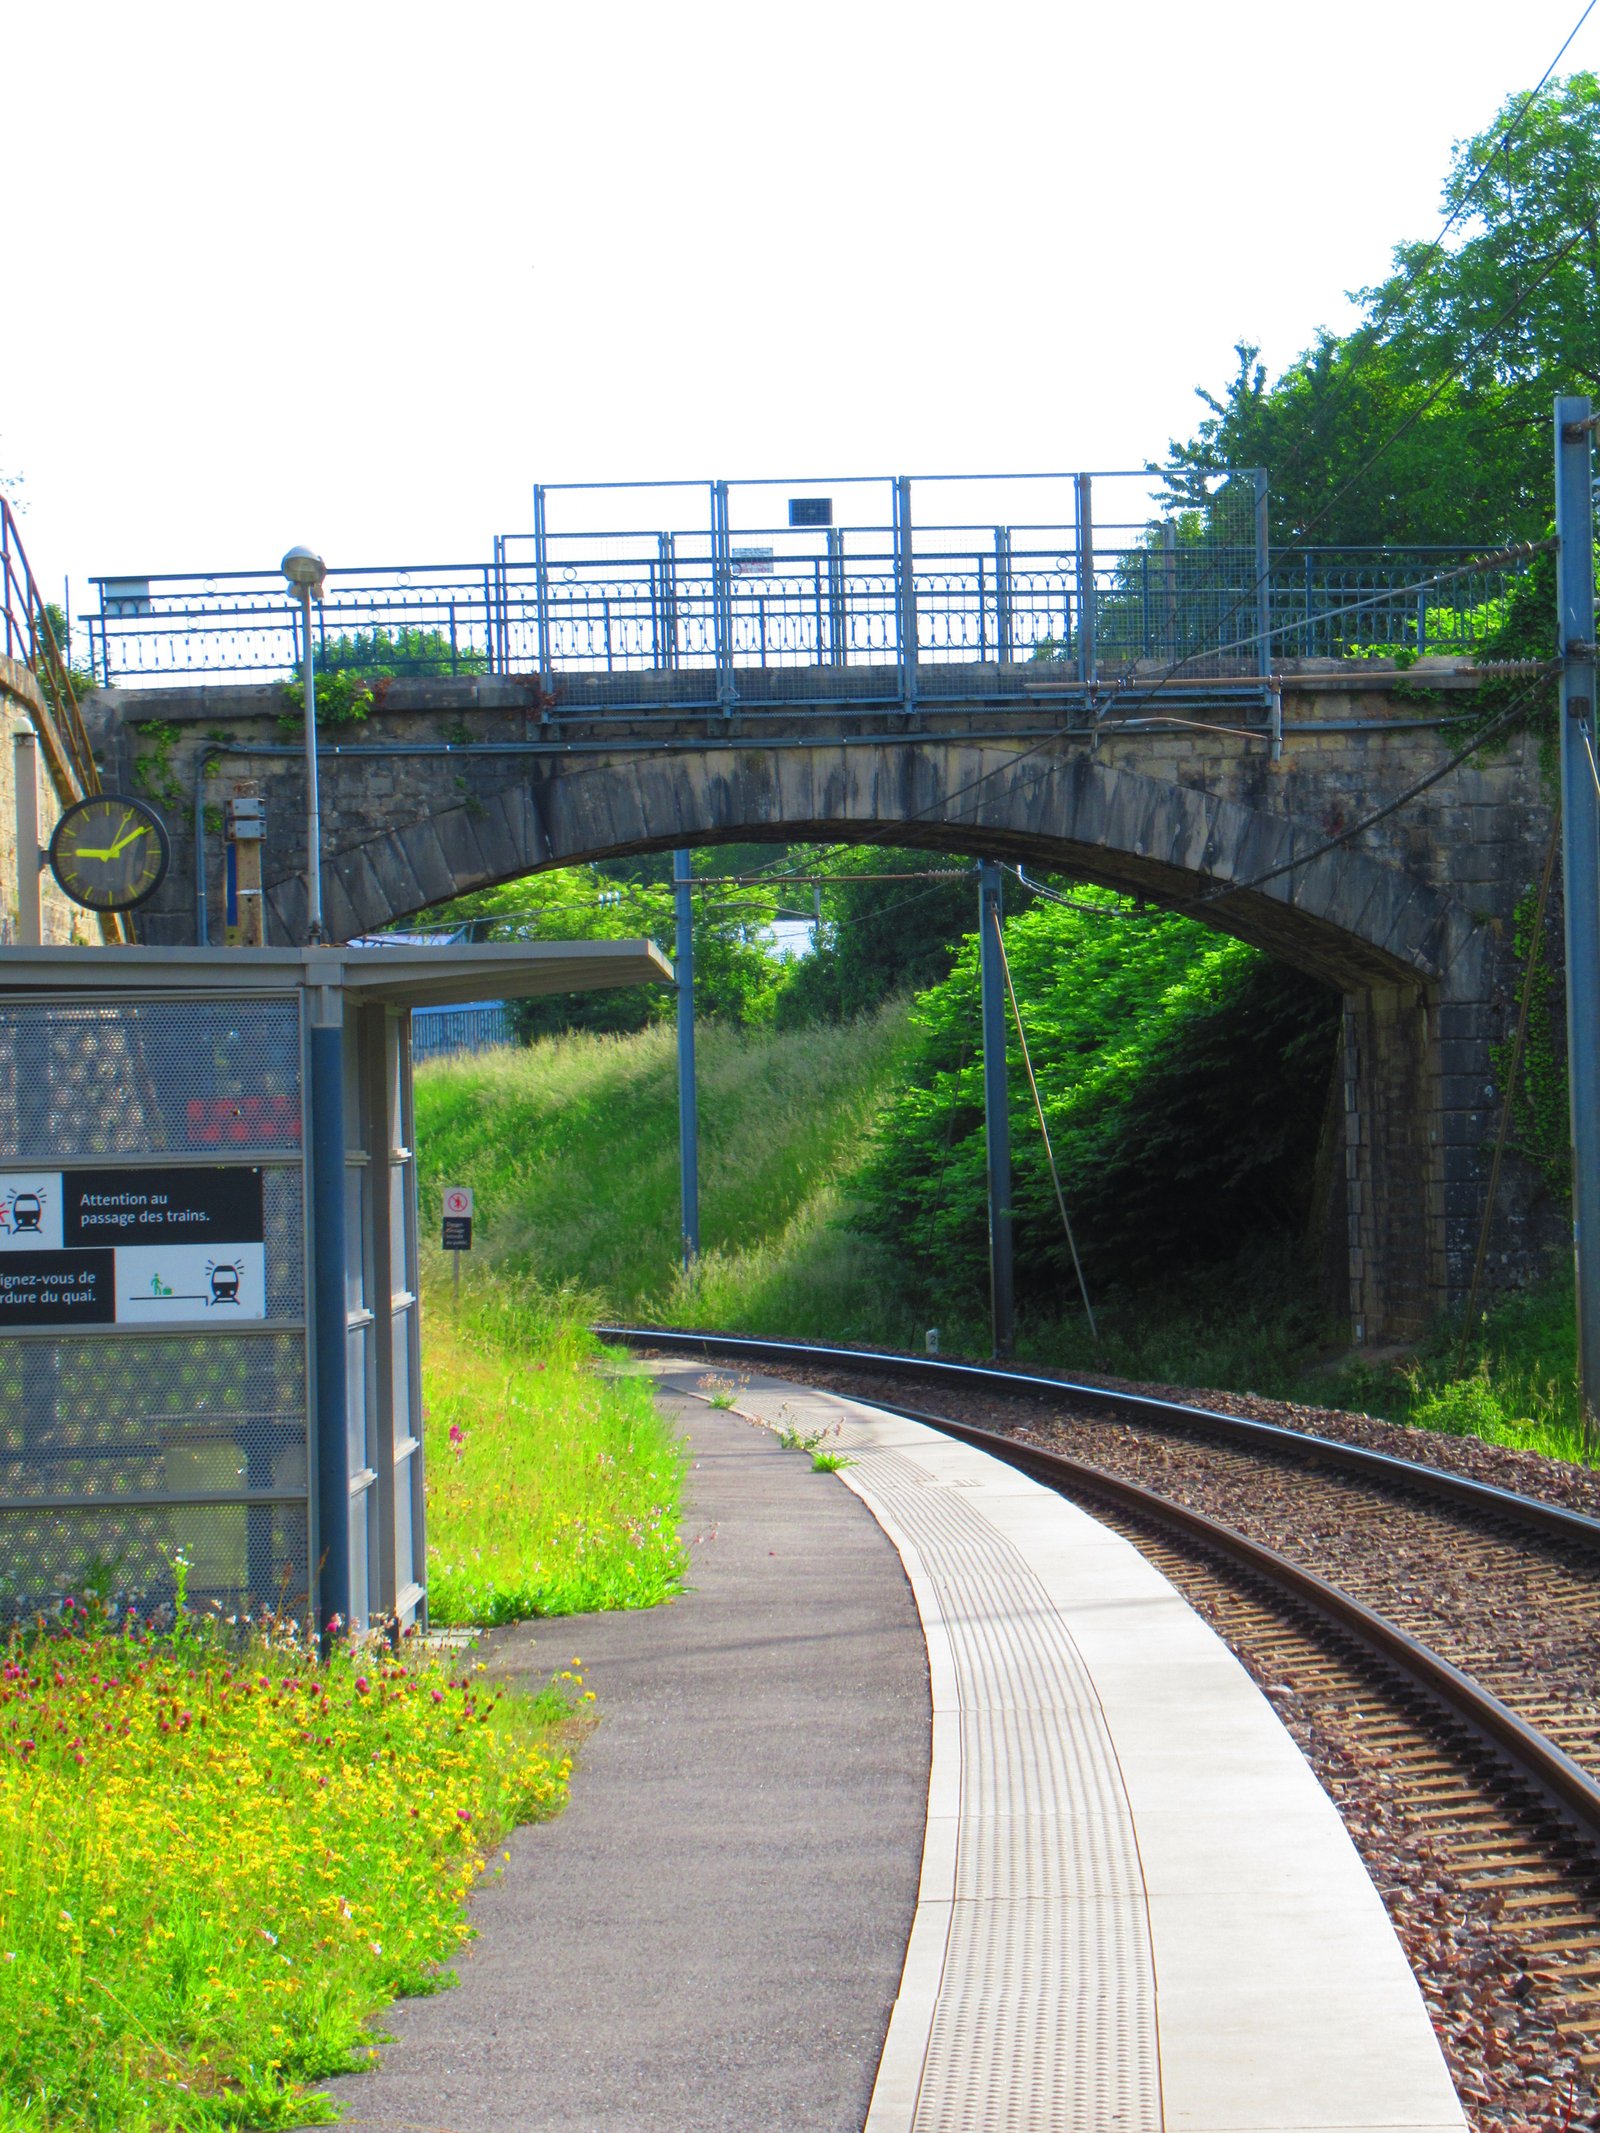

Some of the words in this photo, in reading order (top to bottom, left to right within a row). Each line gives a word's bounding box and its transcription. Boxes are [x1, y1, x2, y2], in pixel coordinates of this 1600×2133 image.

[80, 1193, 147, 1206] Attention
[151, 1195, 168, 1204] au
[81, 1211, 136, 1227] passage
[139, 1211, 163, 1223] des
[167, 1209, 209, 1222] trains.
[78, 1271, 96, 1284] de
[40, 1291, 58, 1303] du
[62, 1289, 96, 1305] quai.
